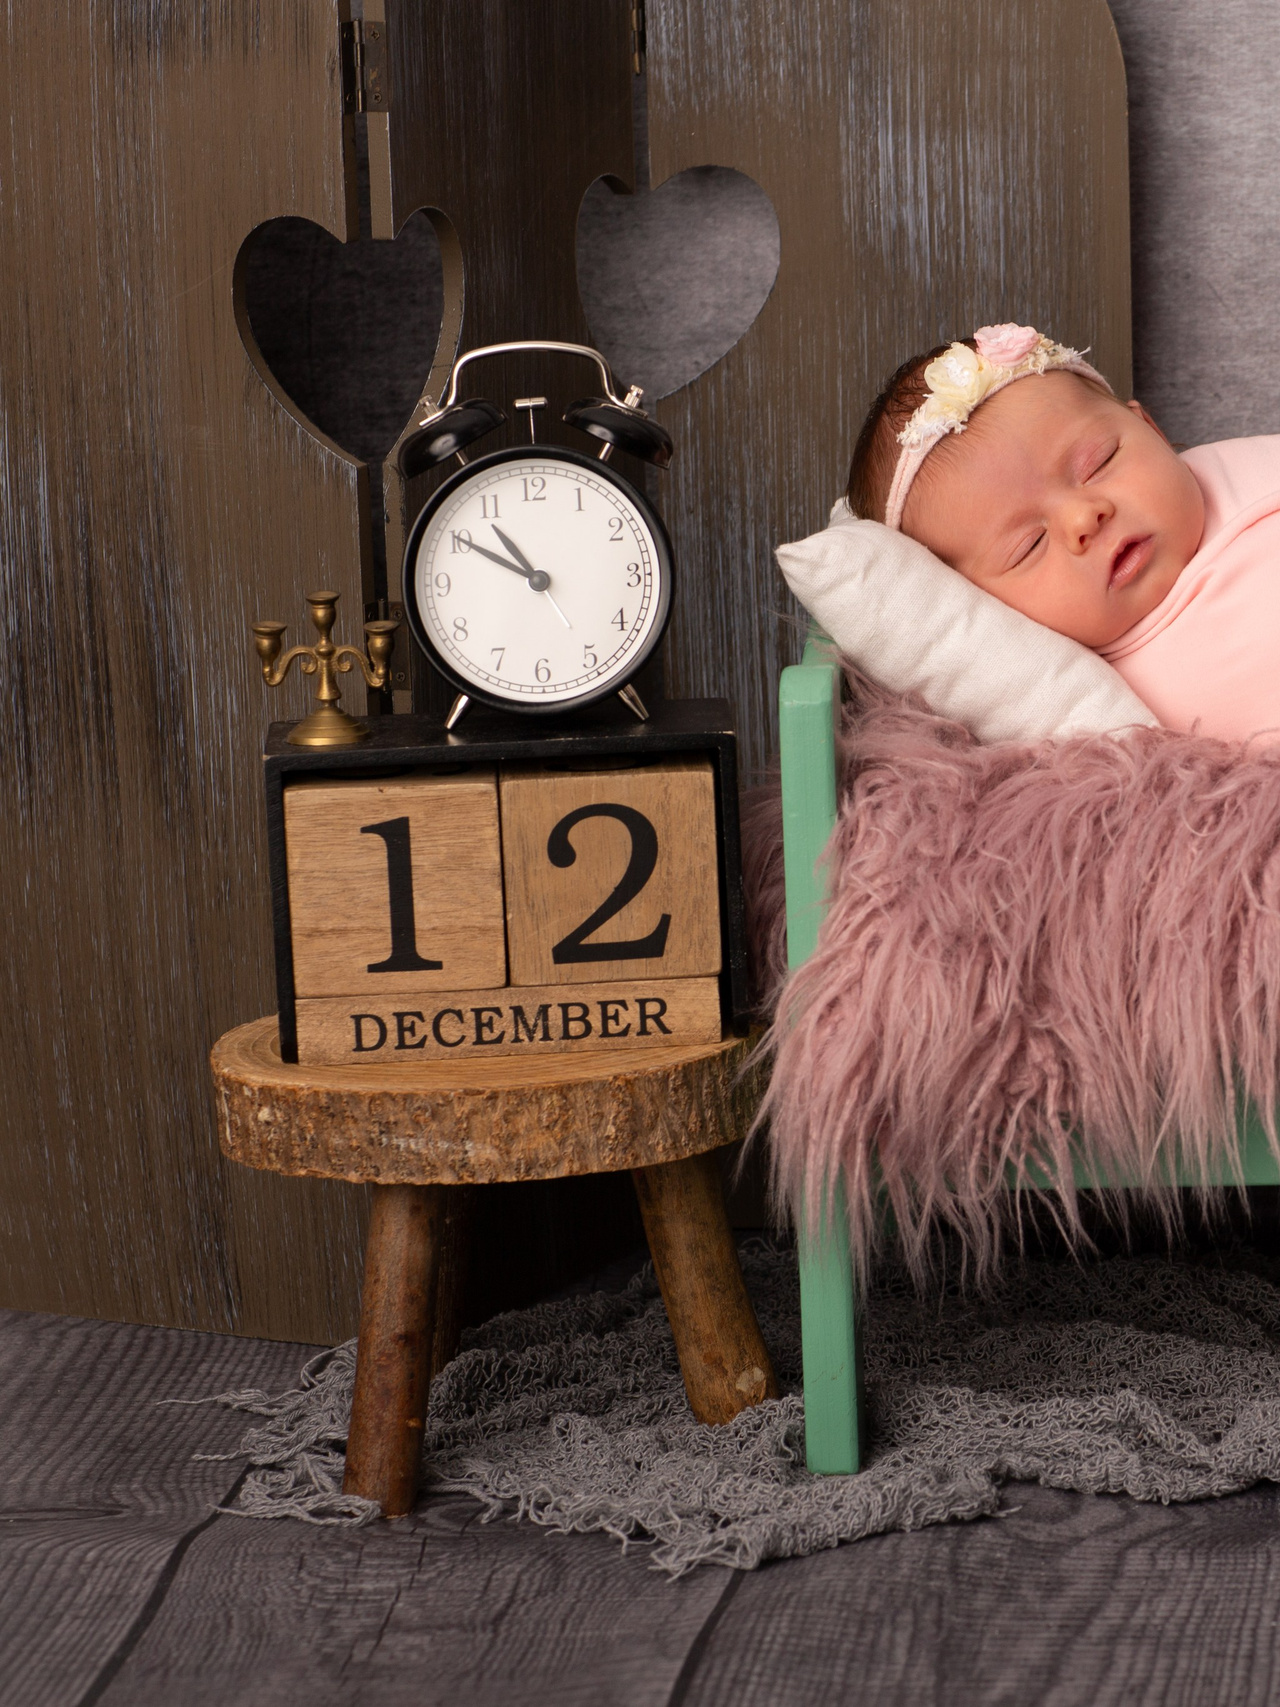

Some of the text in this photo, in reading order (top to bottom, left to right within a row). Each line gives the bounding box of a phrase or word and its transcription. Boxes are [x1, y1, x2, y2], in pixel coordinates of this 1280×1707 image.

[520, 476, 547, 502] 12
[574, 487, 586, 512] 1
[478, 493, 503, 519] 11
[448, 528, 473, 555] 10
[608, 516, 624, 542] 2
[434, 572, 451, 597] 9
[626, 562, 642, 588] 3
[452, 617, 469, 642] 8
[610, 607, 629, 632] 4
[490, 647, 506, 672] 7
[582, 643, 599, 669] 5
[534, 658, 551, 684] 6
[350, 997, 673, 1053] DECEMBER
